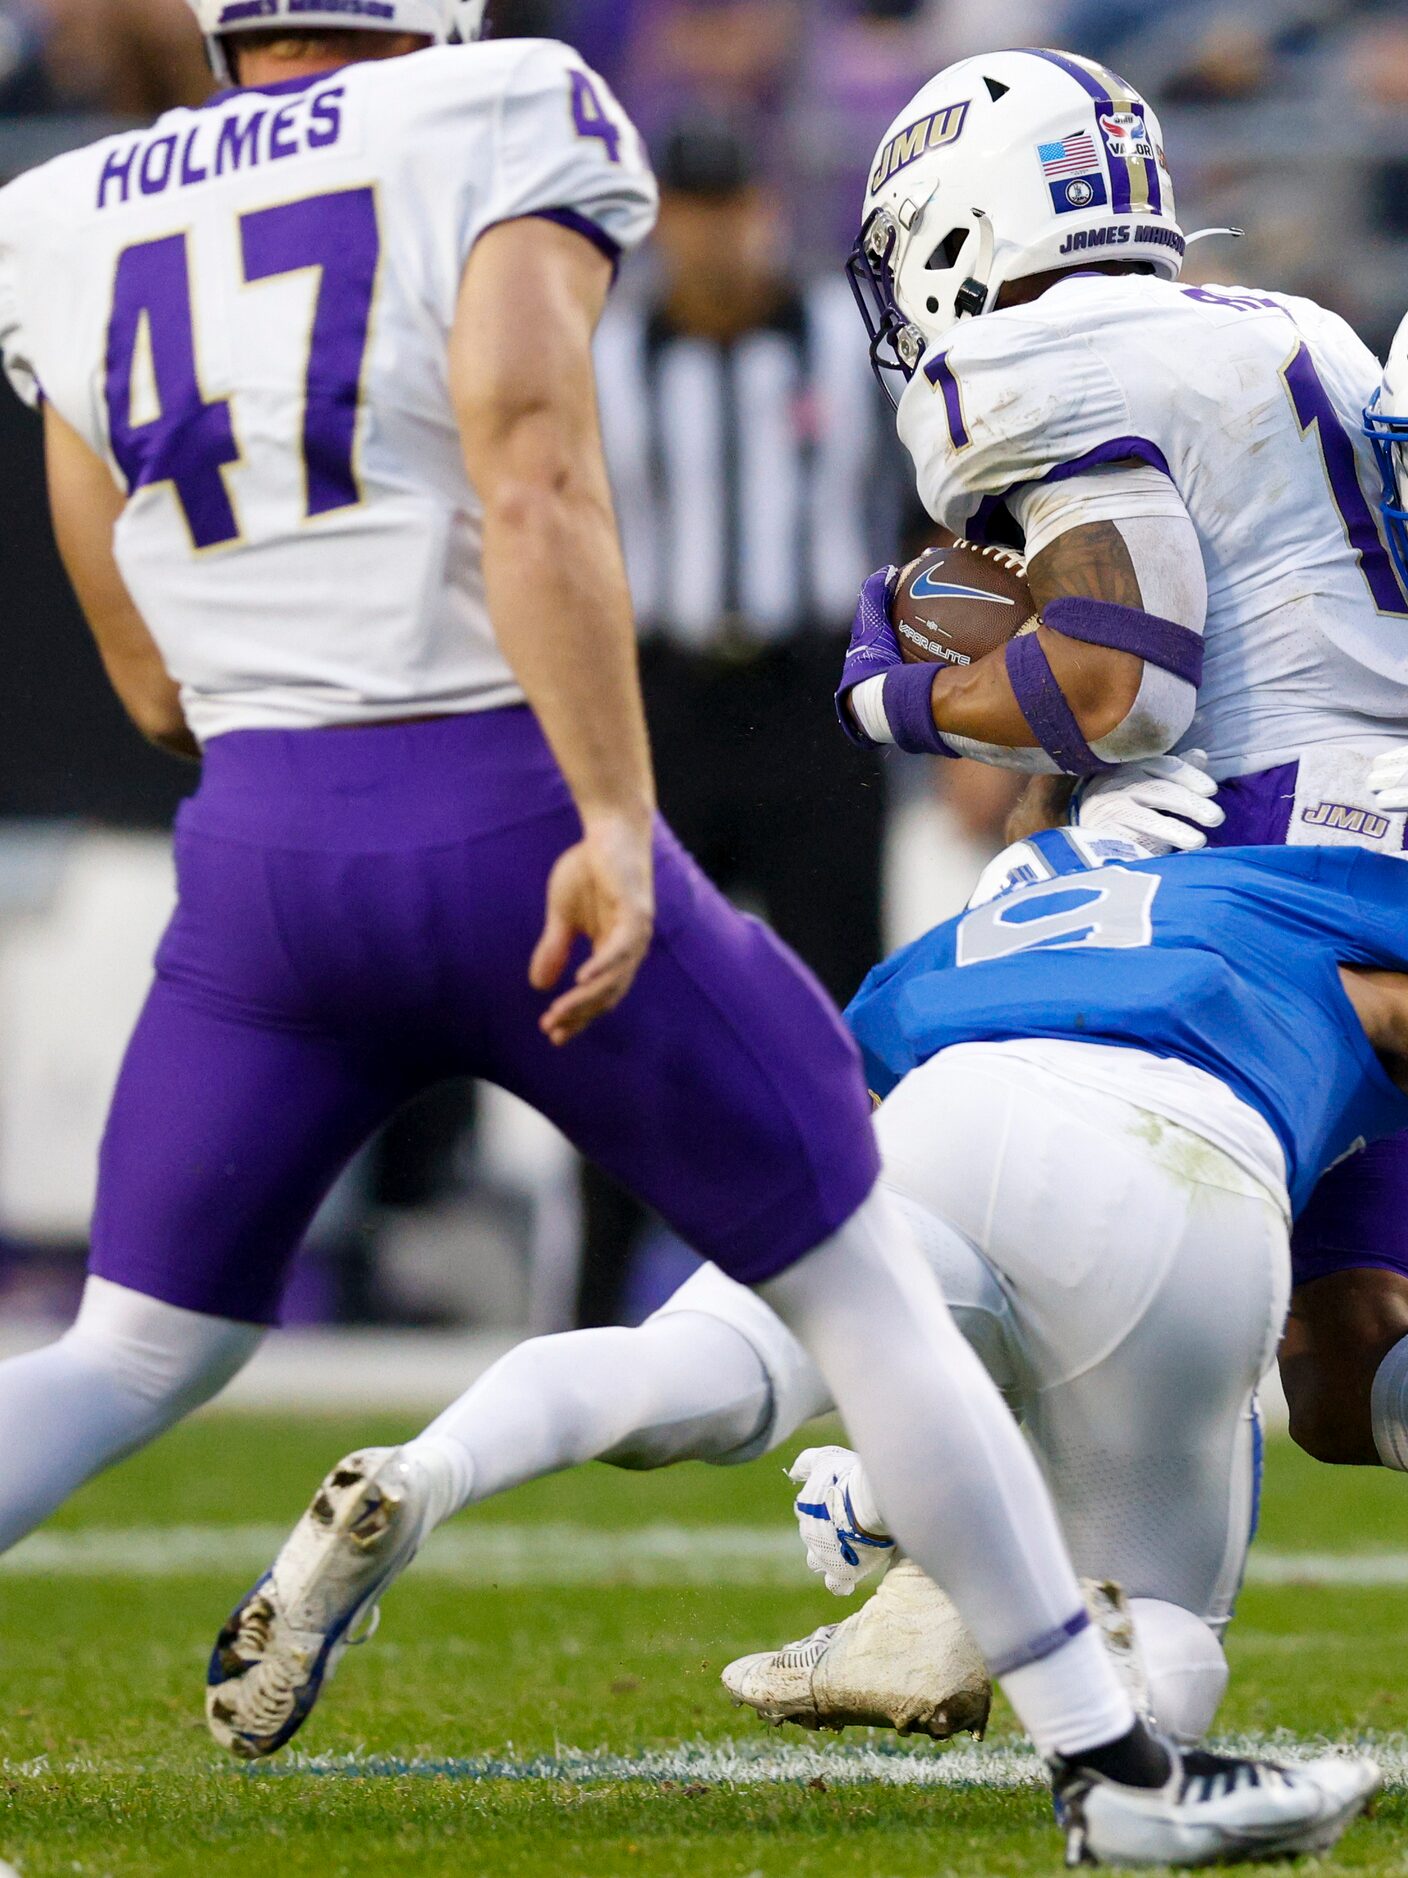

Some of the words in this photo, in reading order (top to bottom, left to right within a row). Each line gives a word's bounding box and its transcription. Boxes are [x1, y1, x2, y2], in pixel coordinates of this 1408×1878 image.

[97, 86, 346, 208] HOLMES
[871, 100, 972, 196] JMU
[1109, 142, 1152, 157] VAOR
[1059, 225, 1131, 254] JAMES
[102, 181, 382, 553] 47
[922, 348, 974, 456] 1
[898, 619, 930, 650] VAPOR
[928, 640, 971, 666] ELITE
[1301, 802, 1391, 840] JMU
[956, 864, 1162, 968] 9
